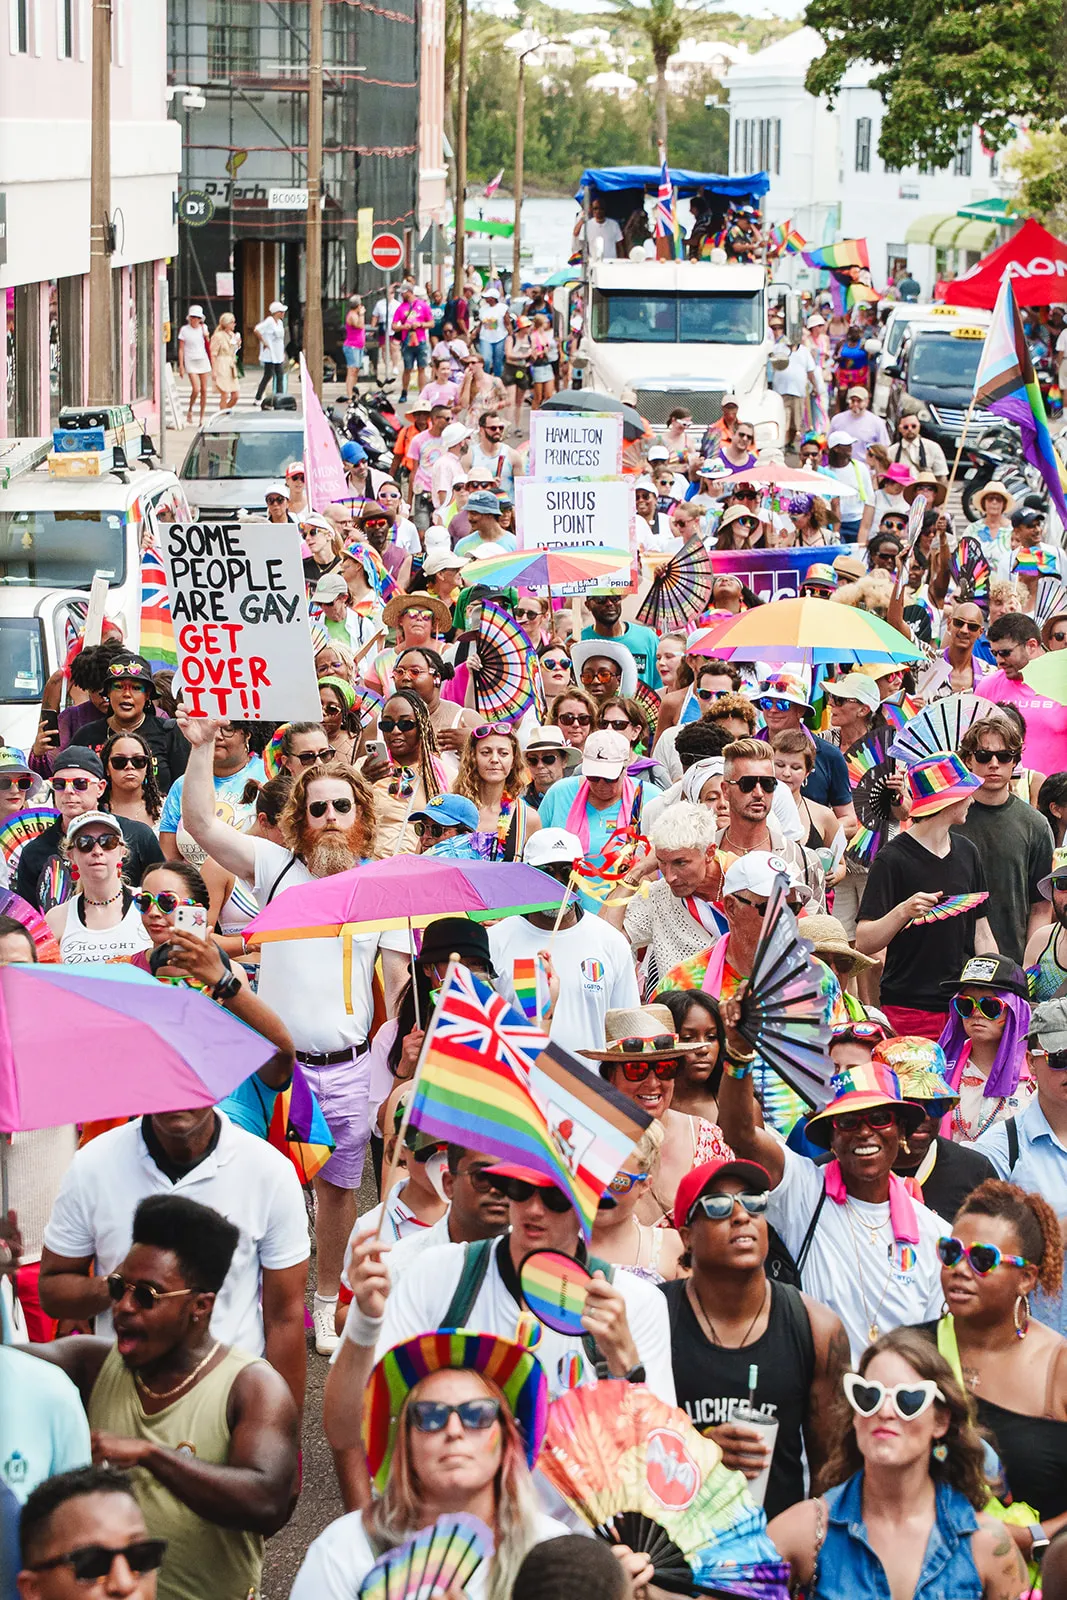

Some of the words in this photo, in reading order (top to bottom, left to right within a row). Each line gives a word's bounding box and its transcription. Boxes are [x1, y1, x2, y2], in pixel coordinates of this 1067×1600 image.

[272, 193, 307, 203] BC0052
[545, 427, 603, 445] HAMILTON
[545, 448, 600, 467] PRINCESS
[546, 491, 596, 511] SIRIUS
[553, 514, 595, 534] POINT
[168, 524, 246, 557] SOME
[171, 557, 287, 593] PEOPLE
[172, 590, 229, 622] ARE
[239, 592, 301, 624] GAY.
[179, 624, 244, 655] GET
[181, 655, 271, 689] OVER
[184, 687, 261, 719] IT!!
[62, 940, 136, 953] THOUGHT
